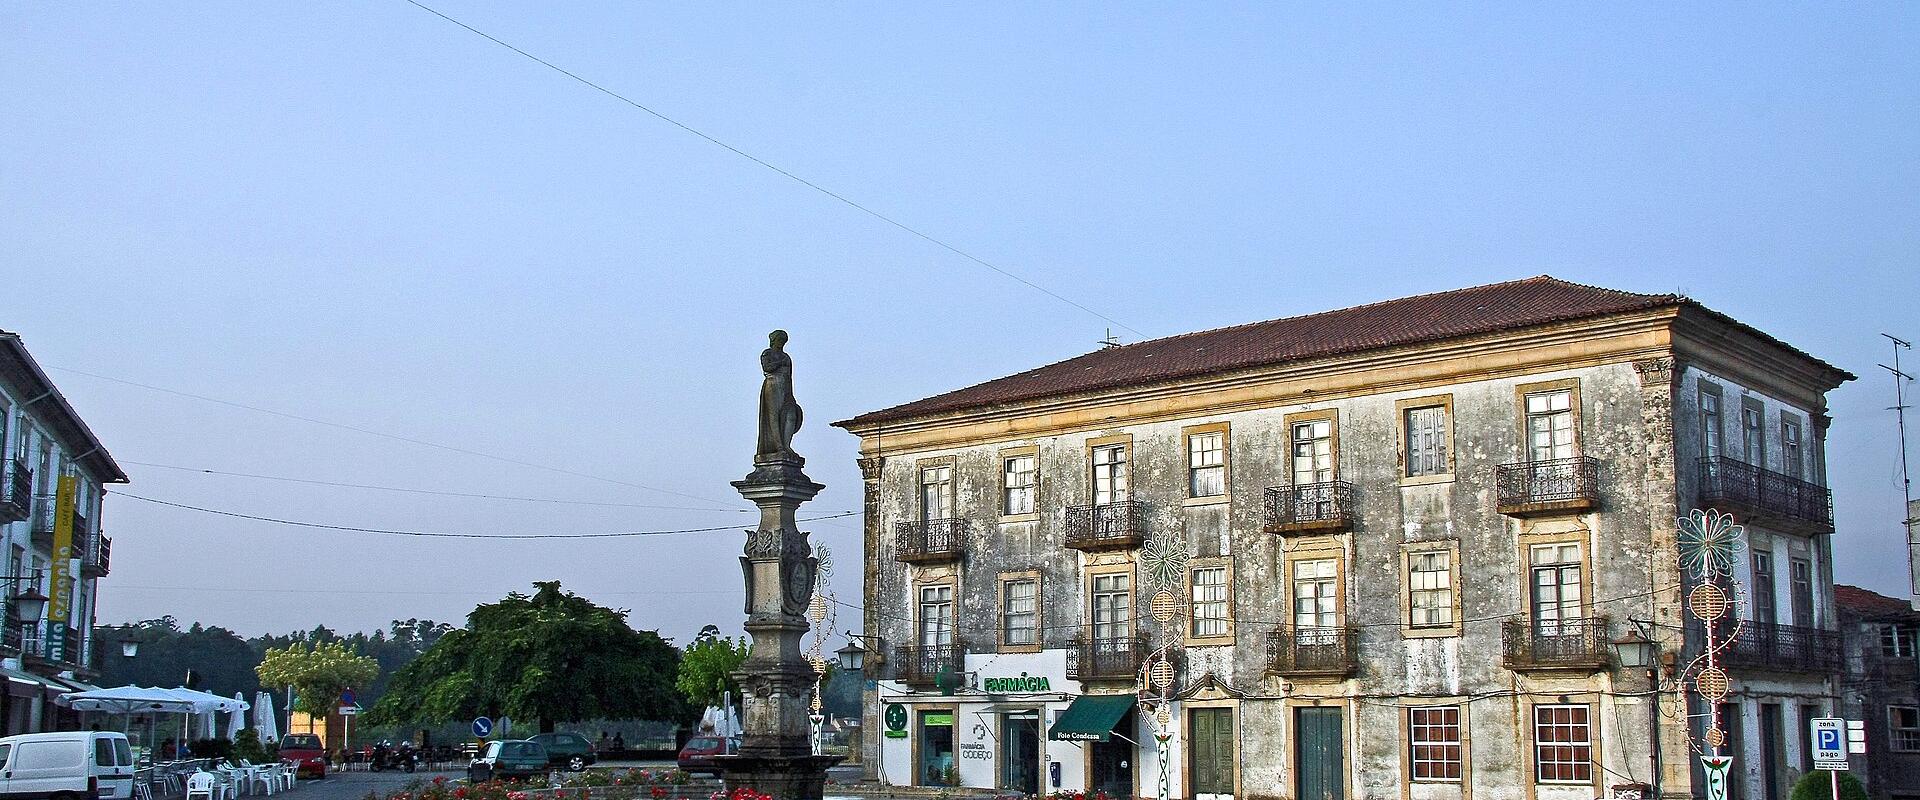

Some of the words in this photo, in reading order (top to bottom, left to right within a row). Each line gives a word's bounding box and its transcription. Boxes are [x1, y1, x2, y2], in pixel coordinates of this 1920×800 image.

[49, 624, 64, 661] mira
[984, 673, 1051, 691] FARMÁCIA
[1822, 731, 1835, 748] P
[963, 750, 992, 761] CODEÇO
